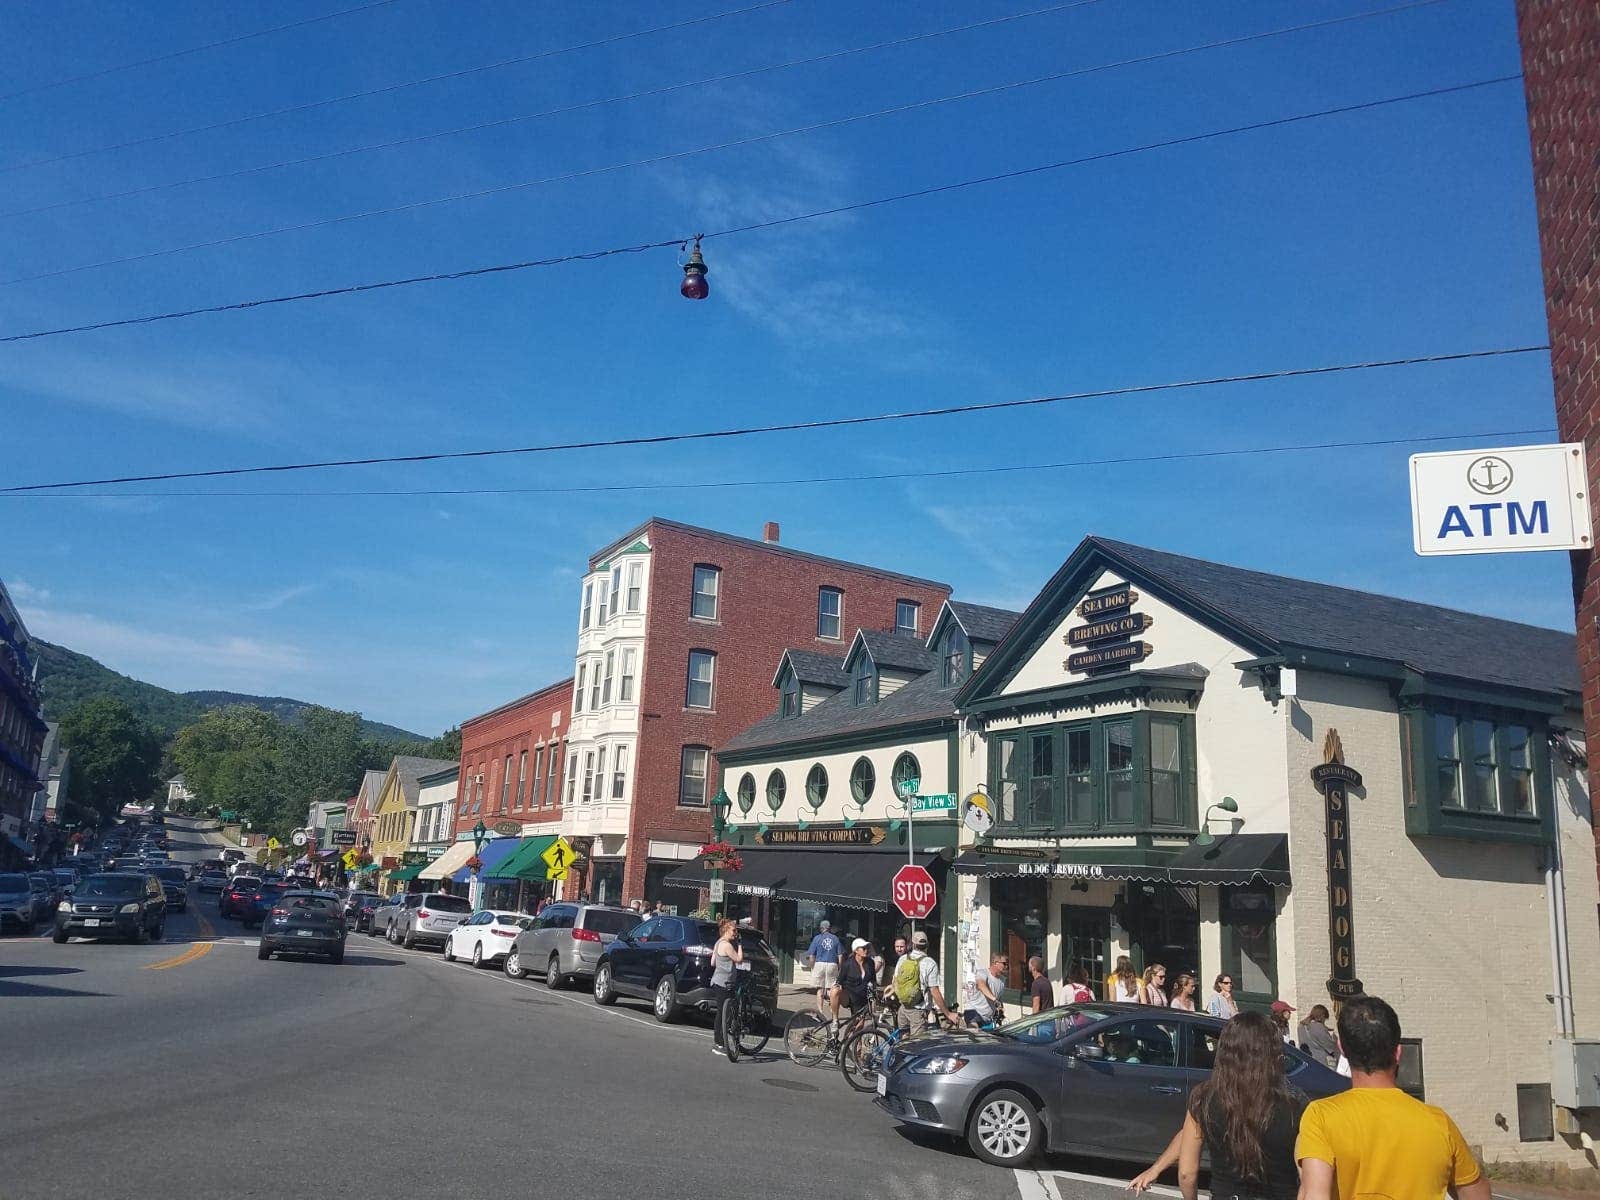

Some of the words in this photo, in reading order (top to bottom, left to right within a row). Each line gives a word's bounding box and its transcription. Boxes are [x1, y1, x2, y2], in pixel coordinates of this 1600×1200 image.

[1437, 500, 1549, 539] ATM
[1084, 599, 1102, 613] SEA
[1105, 593, 1126, 608] DOG
[1073, 621, 1118, 641] BREWING
[1120, 618, 1137, 630] CO.
[1073, 653, 1102, 666] CAMDEN
[1104, 646, 1137, 660] HARBOR
[912, 781, 919, 793] St
[912, 797, 926, 810] Bay
[928, 796, 945, 808] View
[947, 794, 956, 807] St
[771, 830, 783, 842] SEA
[784, 830, 797, 842] DOG
[798, 830, 828, 842] BREWING
[829, 829, 863, 842] COMPANY
[1330, 790, 1347, 870] SEA
[1018, 864, 1033, 874] SEA
[1034, 864, 1050, 874] DOG
[1051, 864, 1089, 875] BREWING
[896, 881, 933, 902] STOP
[1334, 886, 1350, 968] DOG
[1338, 983, 1354, 993] PUB
